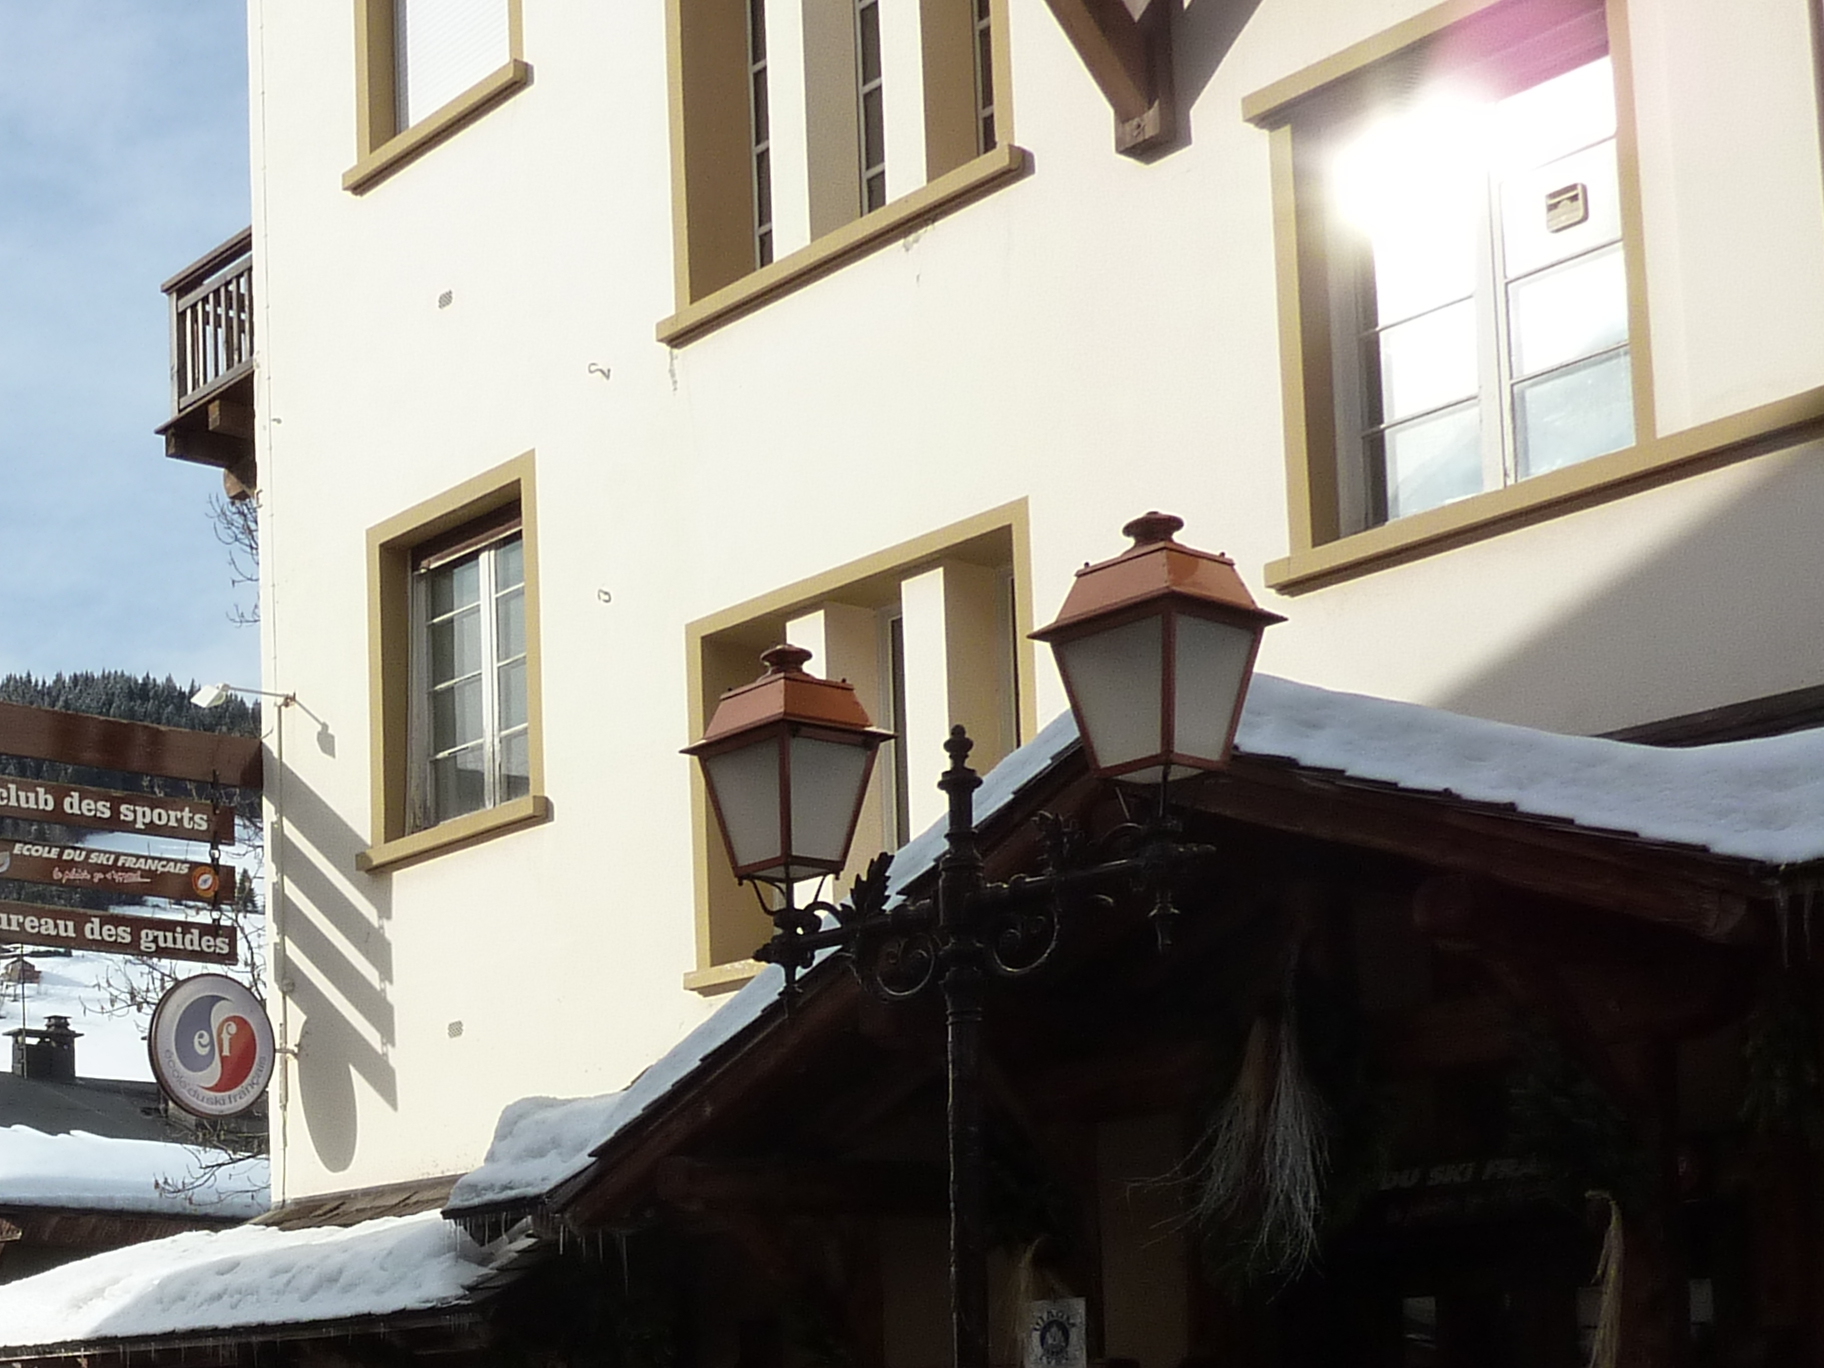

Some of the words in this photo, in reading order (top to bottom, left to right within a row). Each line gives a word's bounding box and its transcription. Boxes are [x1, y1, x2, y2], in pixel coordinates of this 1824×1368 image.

[63, 791, 111, 819] des
[120, 802, 208, 831] sports
[13, 842, 60, 859] ECOLE
[62, 848, 87, 861] DU
[88, 851, 116, 866] SKI
[117, 855, 190, 875] FRANÇAIS
[84, 917, 132, 943] des
[140, 928, 230, 955] guides
